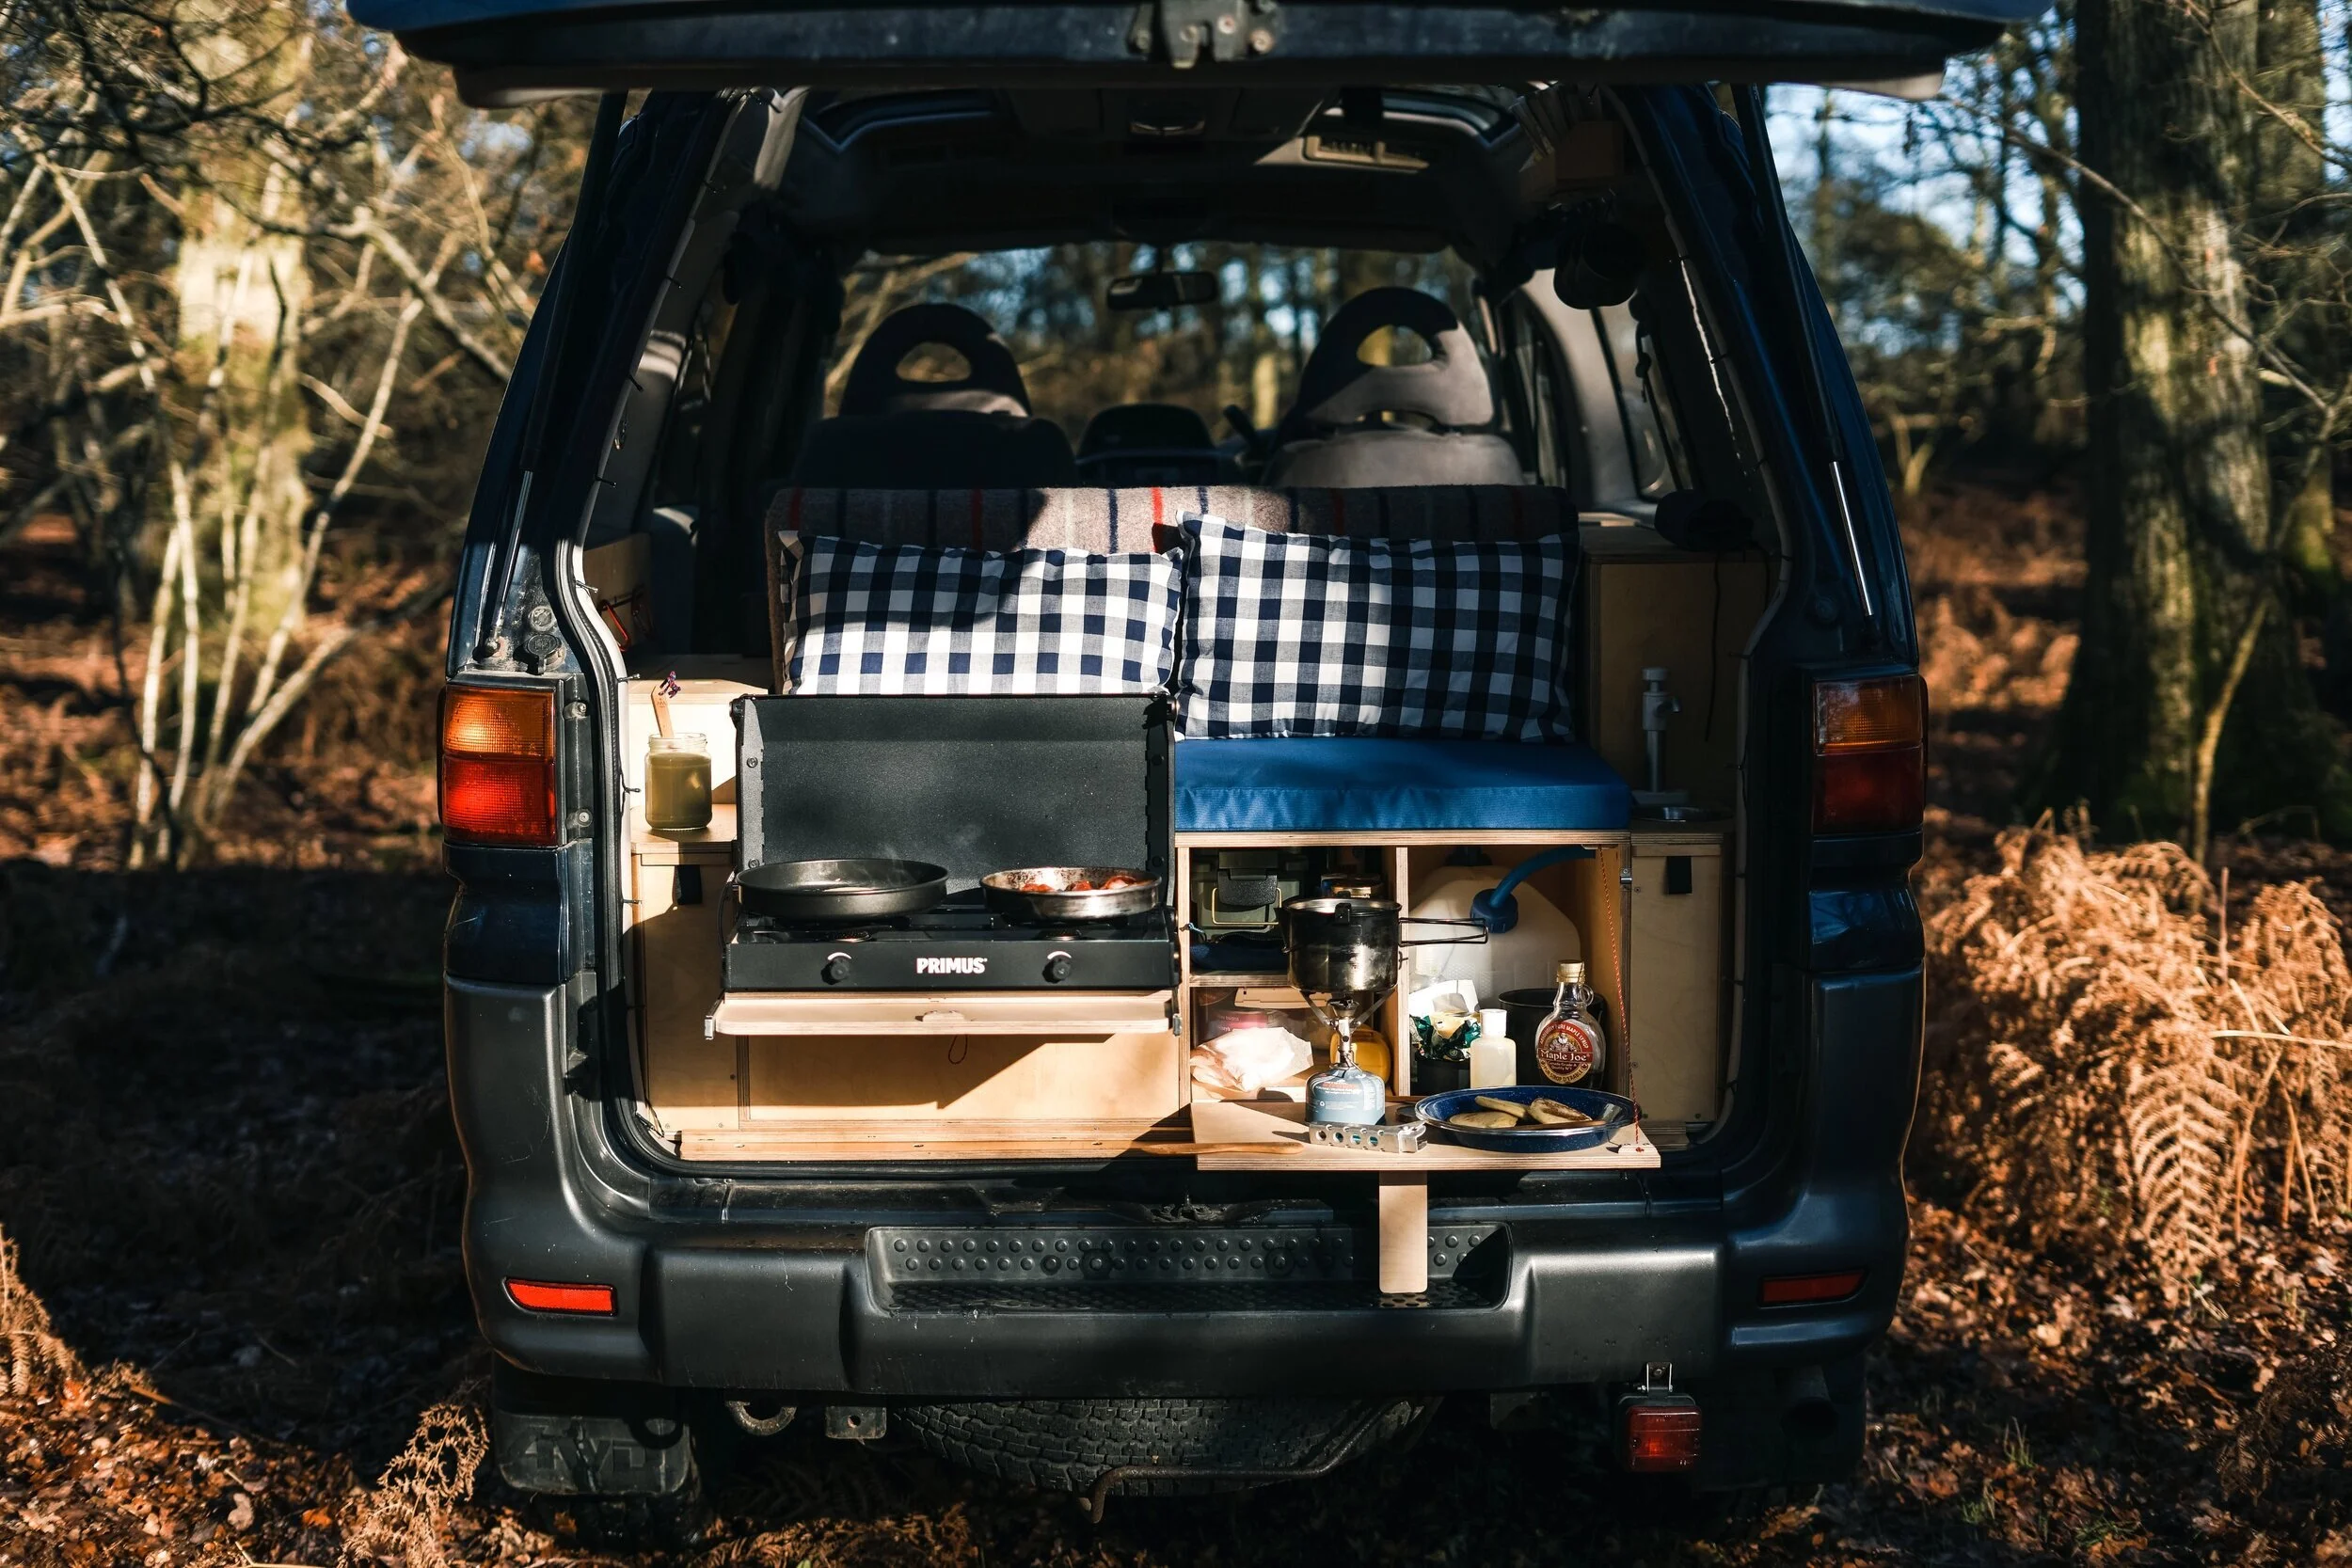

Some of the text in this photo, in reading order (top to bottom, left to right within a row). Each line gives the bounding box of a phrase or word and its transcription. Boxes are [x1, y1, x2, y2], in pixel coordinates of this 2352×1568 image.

[916, 958, 986, 974] PRIMUS
[1565, 1025, 1581, 1037] MAPLE
[1578, 1035, 1589, 1049] SYRUP
[1540, 1049, 1587, 1061] Maple Joe
